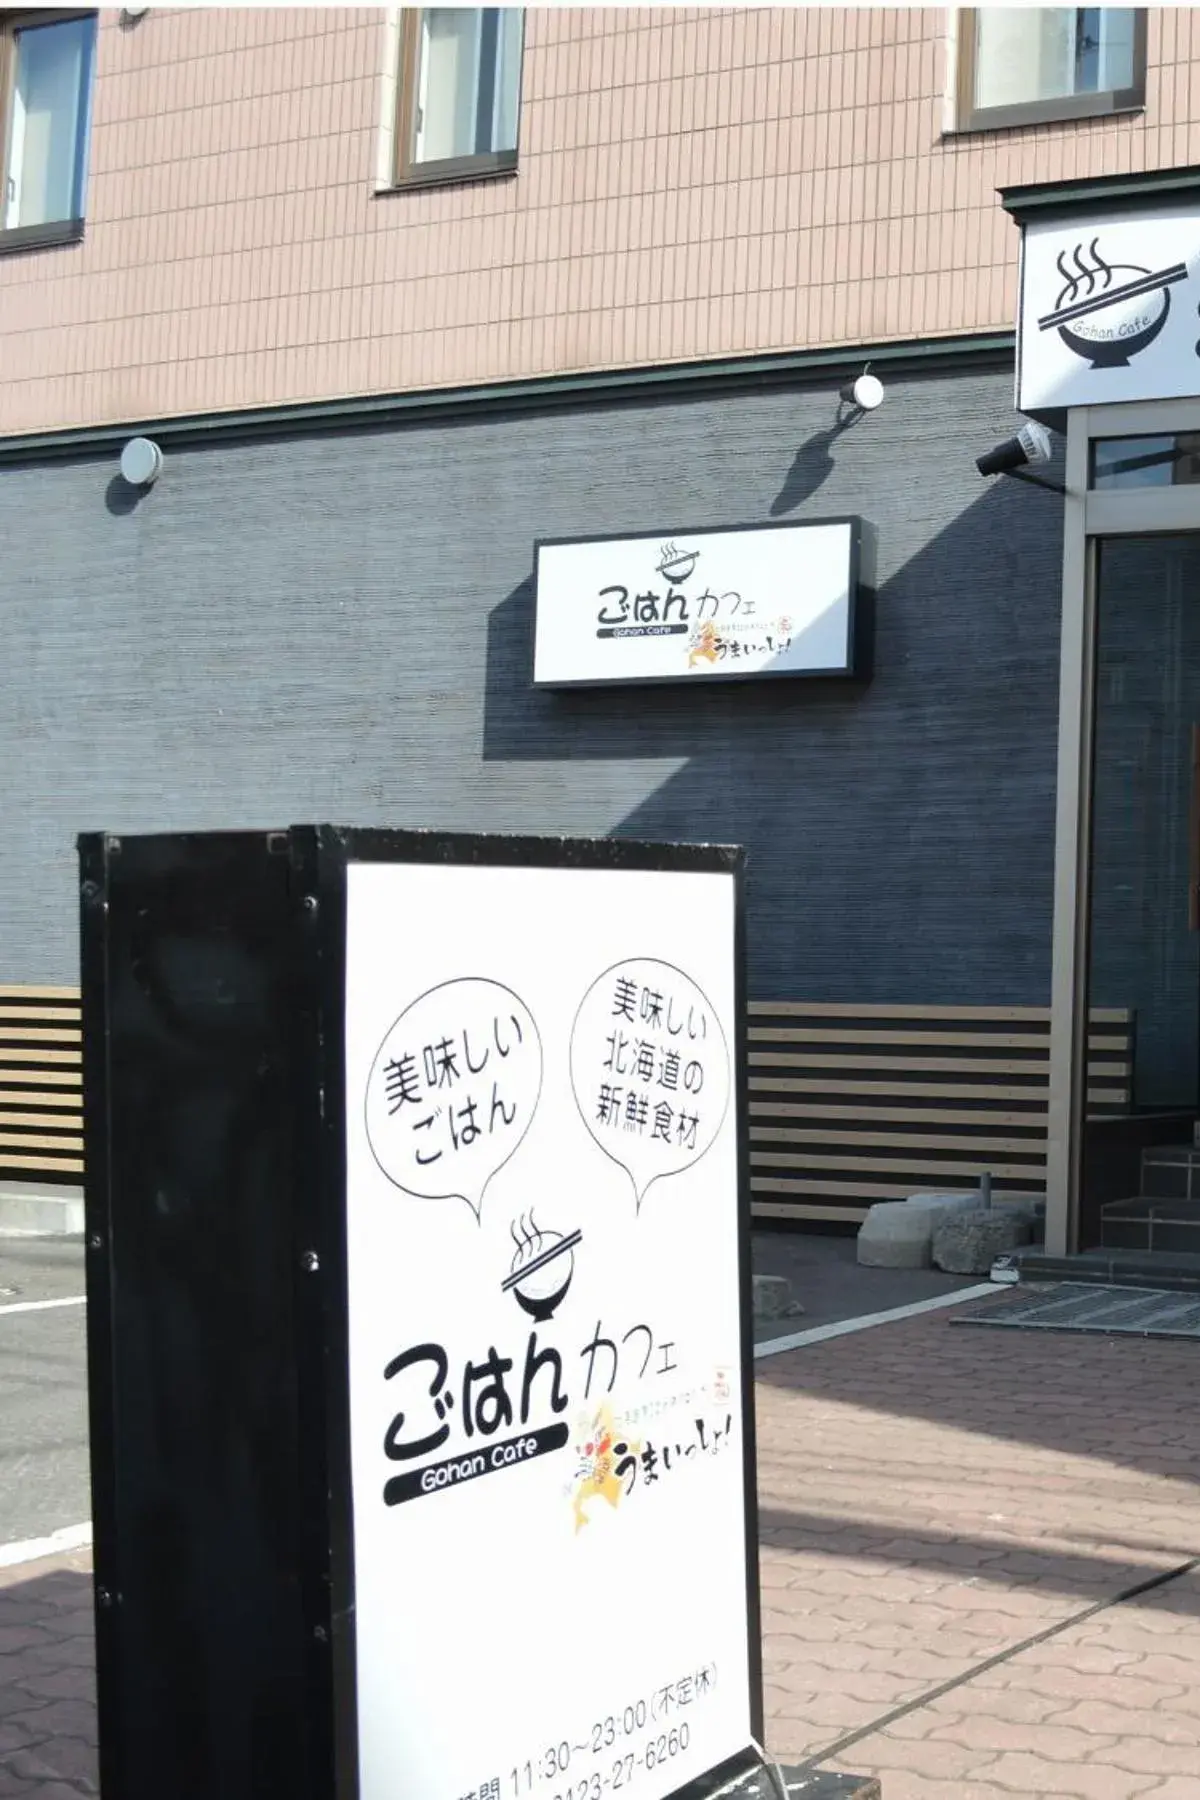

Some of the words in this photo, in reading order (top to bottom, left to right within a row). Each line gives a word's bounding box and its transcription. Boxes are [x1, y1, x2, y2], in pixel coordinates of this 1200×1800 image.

[611, 975, 707, 1040] 美味しい
[382, 1014, 523, 1116] 美味しい
[603, 1029, 704, 1096] 北海道の
[412, 1082, 517, 1165] ごはん
[596, 1083, 700, 1151] 新鮮食材
[421, 1454, 485, 1492] Gohan
[490, 1436, 538, 1468] Cafe
[553, 1722, 690, 1800] 23-27-6260
